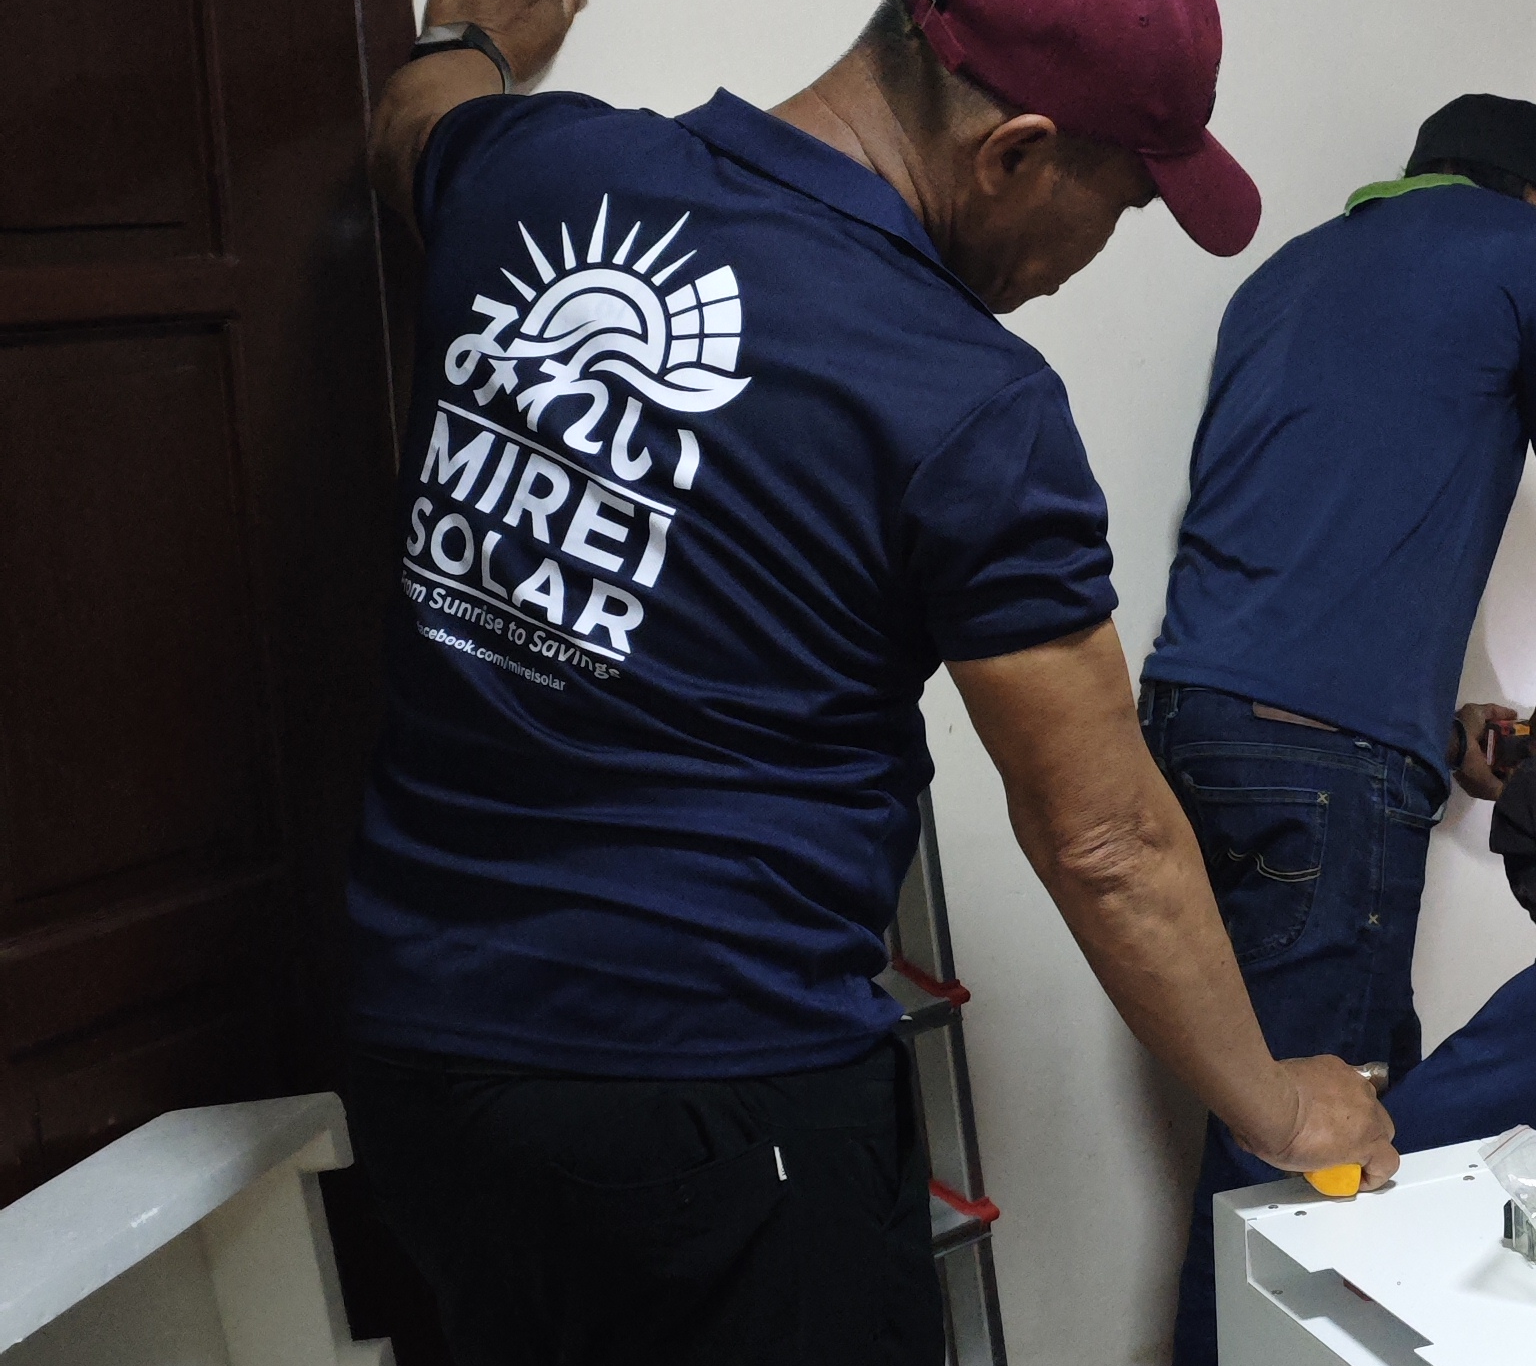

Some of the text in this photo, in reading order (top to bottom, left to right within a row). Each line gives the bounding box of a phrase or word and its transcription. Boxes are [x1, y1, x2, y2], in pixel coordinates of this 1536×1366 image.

[419, 411, 672, 588] MIREI
[406, 497, 644, 654] SOLAR
[429, 587, 503, 635] Sunrise
[507, 621, 526, 645] to
[416, 621, 566, 691] acebook.com/mireisolar
